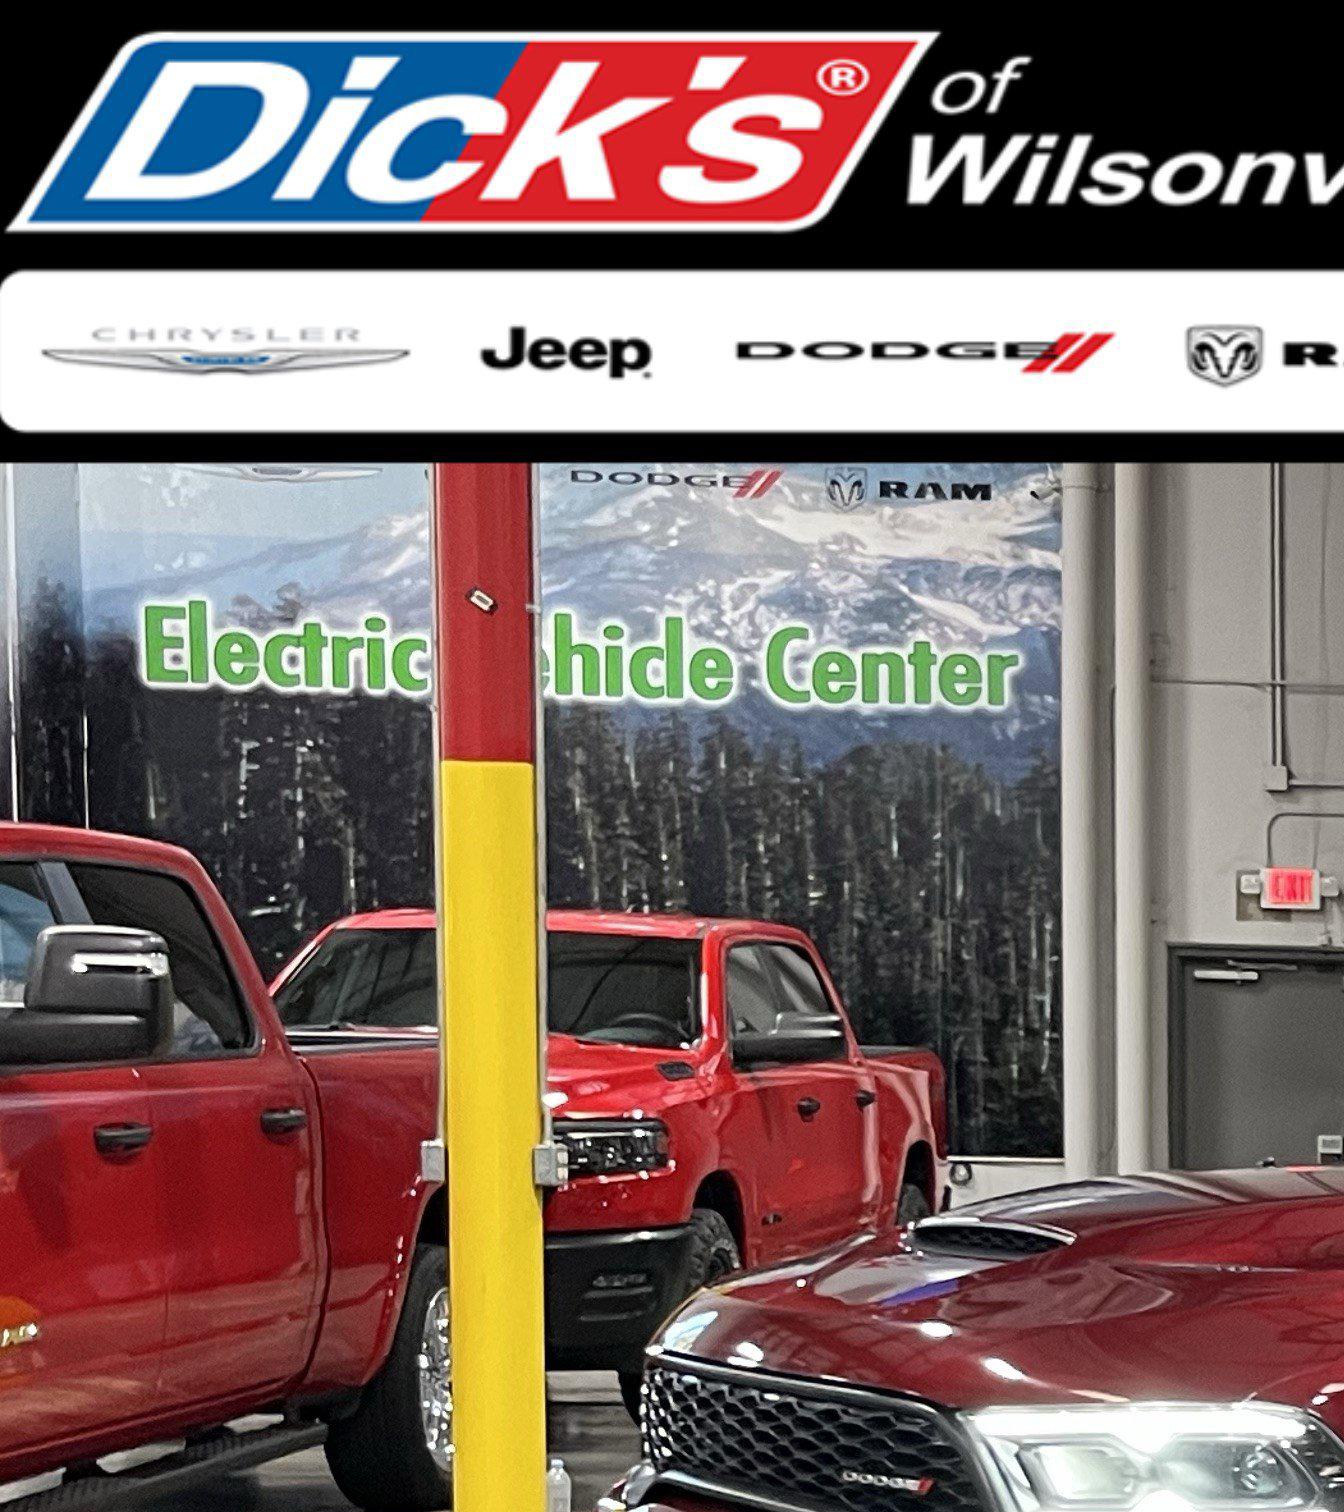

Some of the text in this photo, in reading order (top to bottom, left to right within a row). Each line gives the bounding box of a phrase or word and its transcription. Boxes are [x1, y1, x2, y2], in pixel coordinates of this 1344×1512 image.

[571, 470, 750, 488] DODGE
[879, 480, 993, 501] RAM
[144, 600, 1019, 707] Electric hicle Center
[842, 1470, 921, 1492] DODGE
